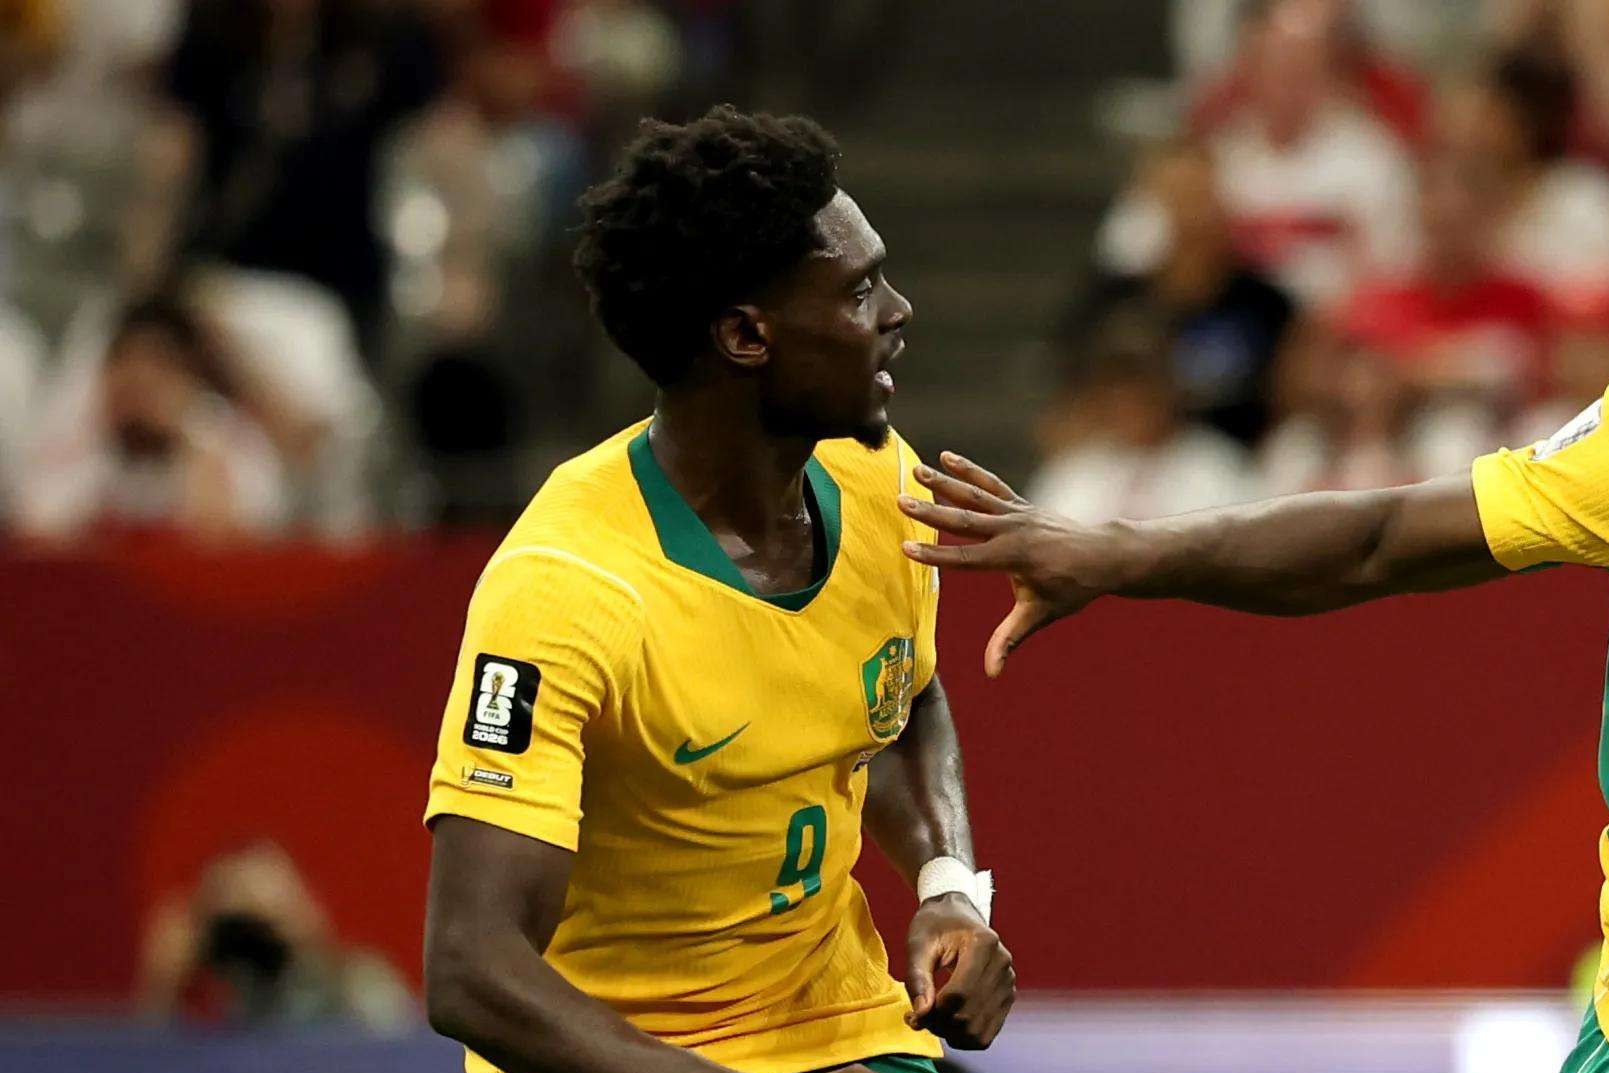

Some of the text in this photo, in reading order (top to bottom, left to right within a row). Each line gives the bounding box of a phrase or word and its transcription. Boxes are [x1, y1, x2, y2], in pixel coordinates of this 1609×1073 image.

[483, 711, 500, 720] FIFA
[474, 770, 511, 782] DEBUT
[770, 804, 827, 914] 9
